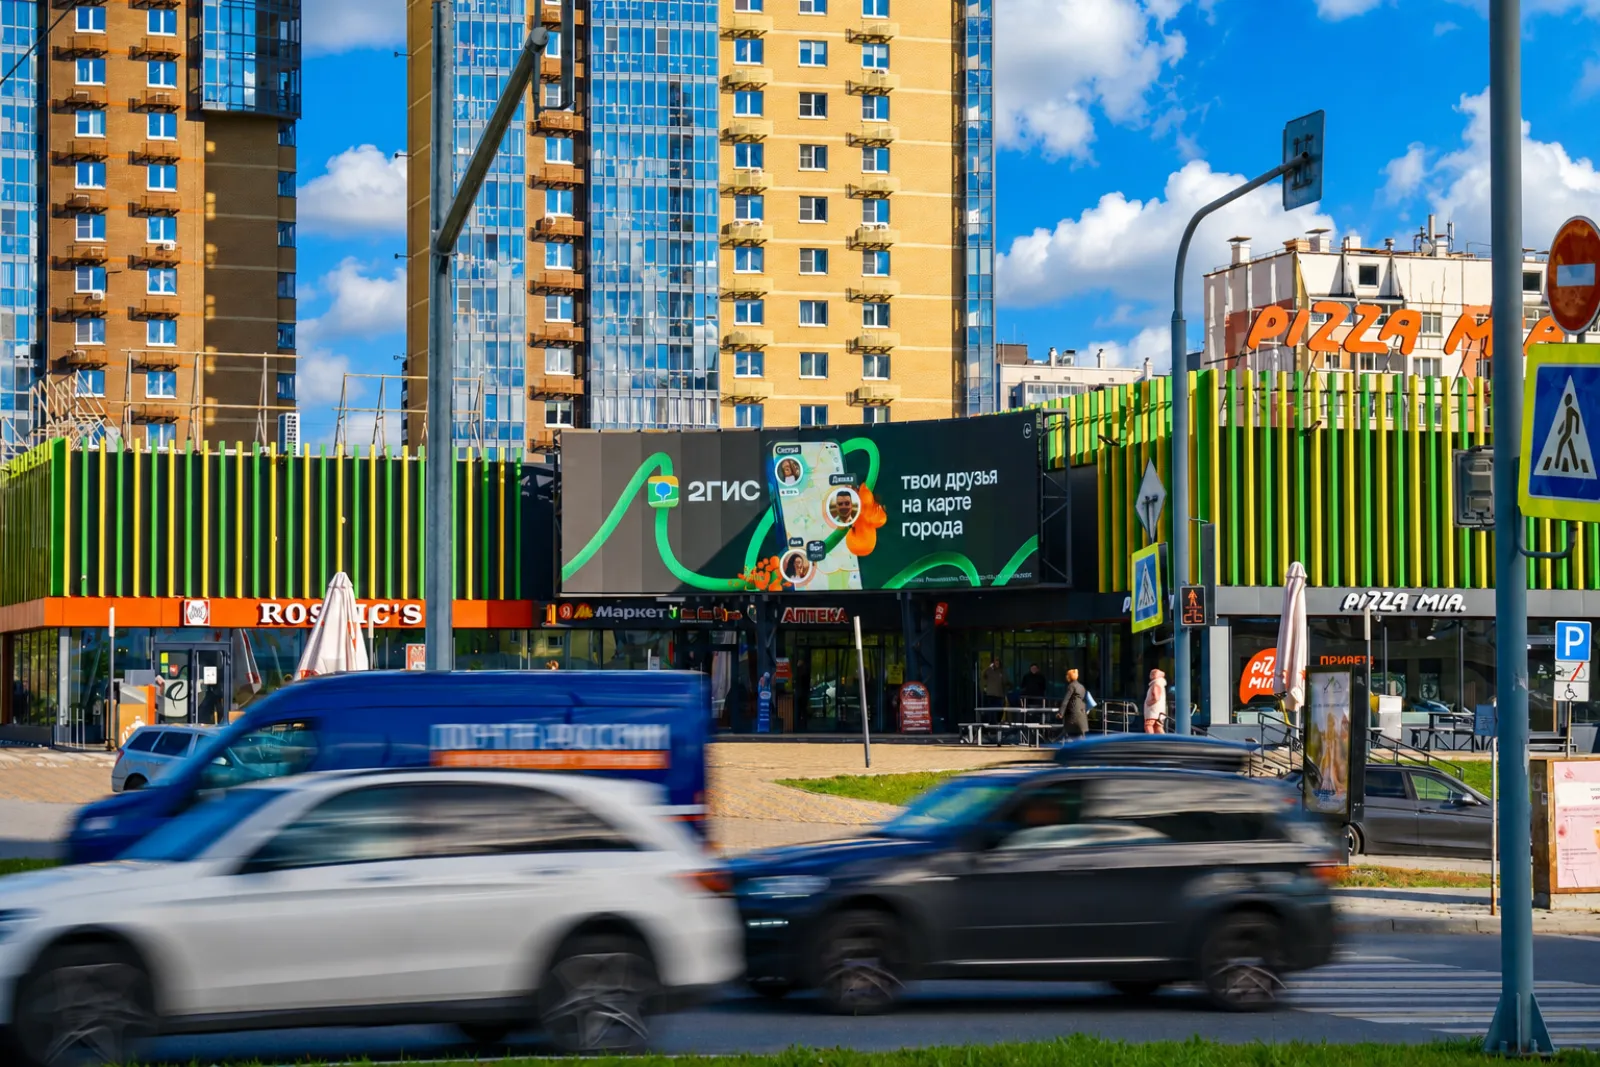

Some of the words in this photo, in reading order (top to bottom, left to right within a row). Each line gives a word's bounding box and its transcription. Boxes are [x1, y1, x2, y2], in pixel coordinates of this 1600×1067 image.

[1246, 301, 1421, 356] PIZZA
[901, 474, 941, 490] твои
[945, 469, 998, 491] друзья
[687, 480, 761, 502] 2ГИС
[902, 499, 922, 513] на
[927, 495, 972, 516] карте
[902, 519, 964, 540] города
[1343, 590, 1409, 611] PIZZA
[260, 602, 423, 625] ROSIC'S
[595, 605, 667, 620] Маркет
[781, 606, 850, 623] АПТЕКА
[1565, 626, 1584, 656] P
[1250, 656, 1276, 676] PIZ
